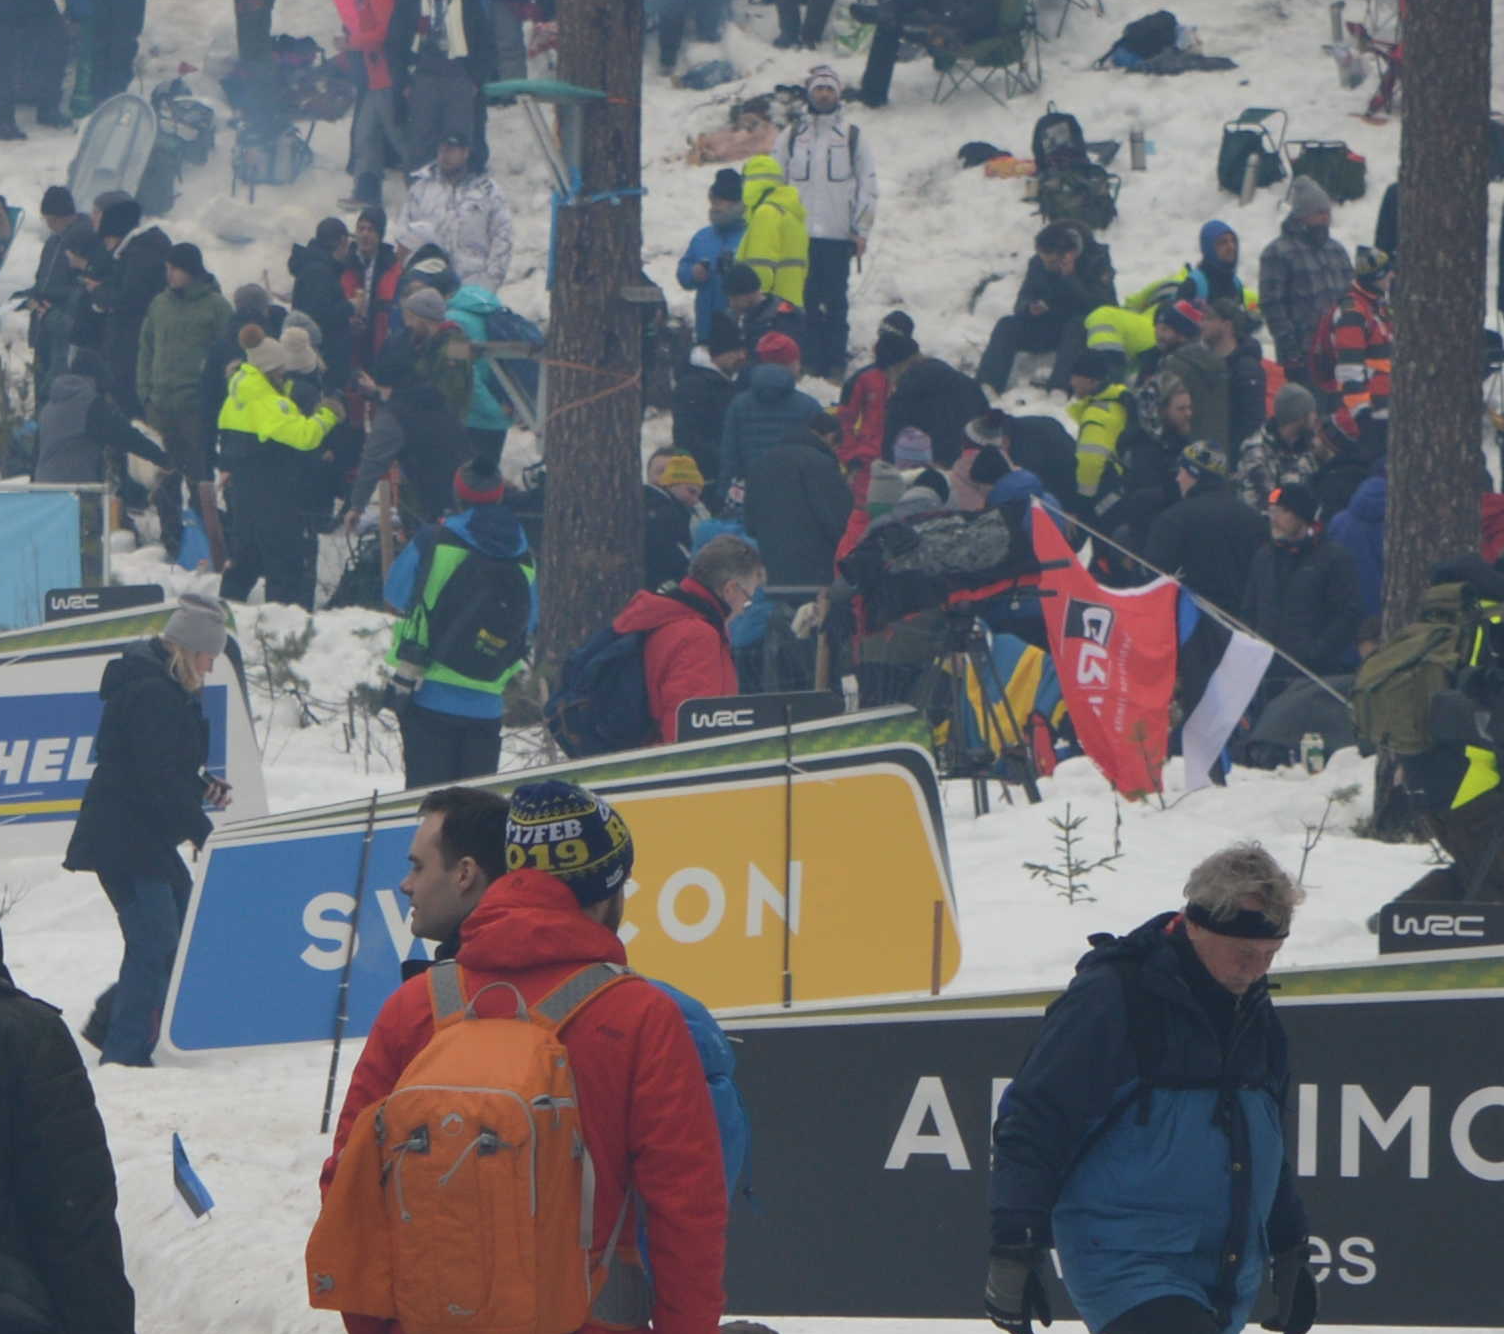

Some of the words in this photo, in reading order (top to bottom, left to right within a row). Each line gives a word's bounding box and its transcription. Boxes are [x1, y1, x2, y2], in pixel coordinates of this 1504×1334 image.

[691, 709, 755, 729] WRC
[506, 838, 590, 871] 019
[1393, 914, 1485, 937] WRC
